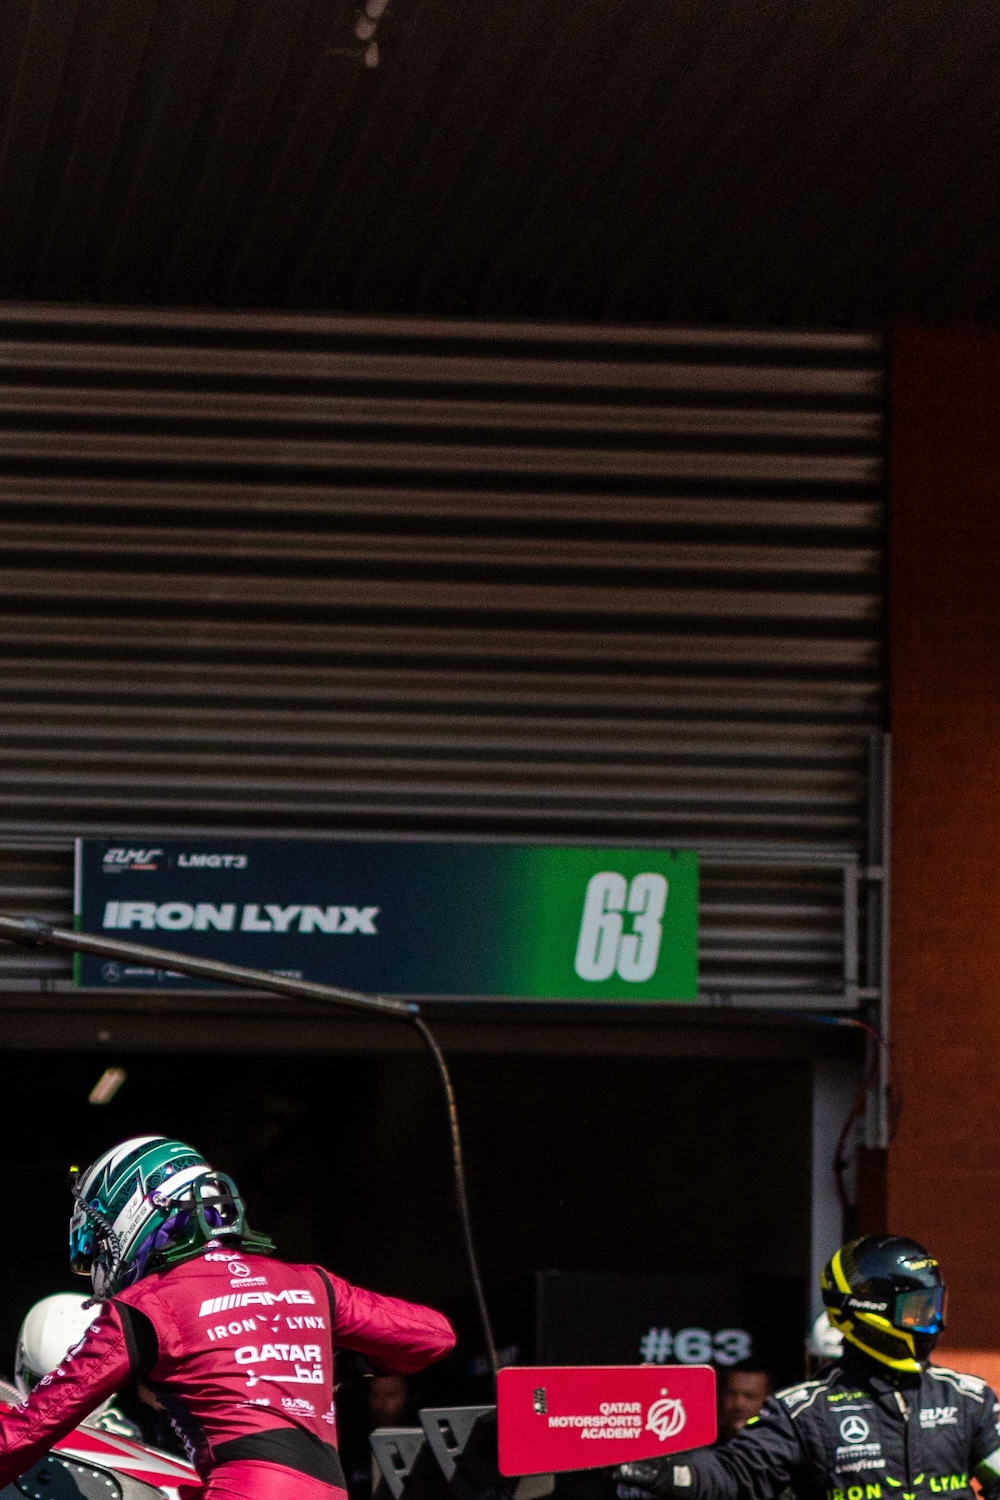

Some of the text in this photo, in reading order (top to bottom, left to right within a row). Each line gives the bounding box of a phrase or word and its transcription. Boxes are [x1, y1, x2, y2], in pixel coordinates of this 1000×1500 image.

[177, 853, 247, 869] LMGT3
[103, 901, 380, 934] IRON LYNX
[574, 871, 668, 983] 63
[206, 1316, 325, 1341] IRON LYNX
[234, 1344, 322, 1365] QATAR
[639, 1327, 752, 1366] #63
[599, 1402, 642, 1415] QATAR
[548, 1415, 643, 1428] MOTORSPORTS
[580, 1427, 643, 1440] ACADEMY
